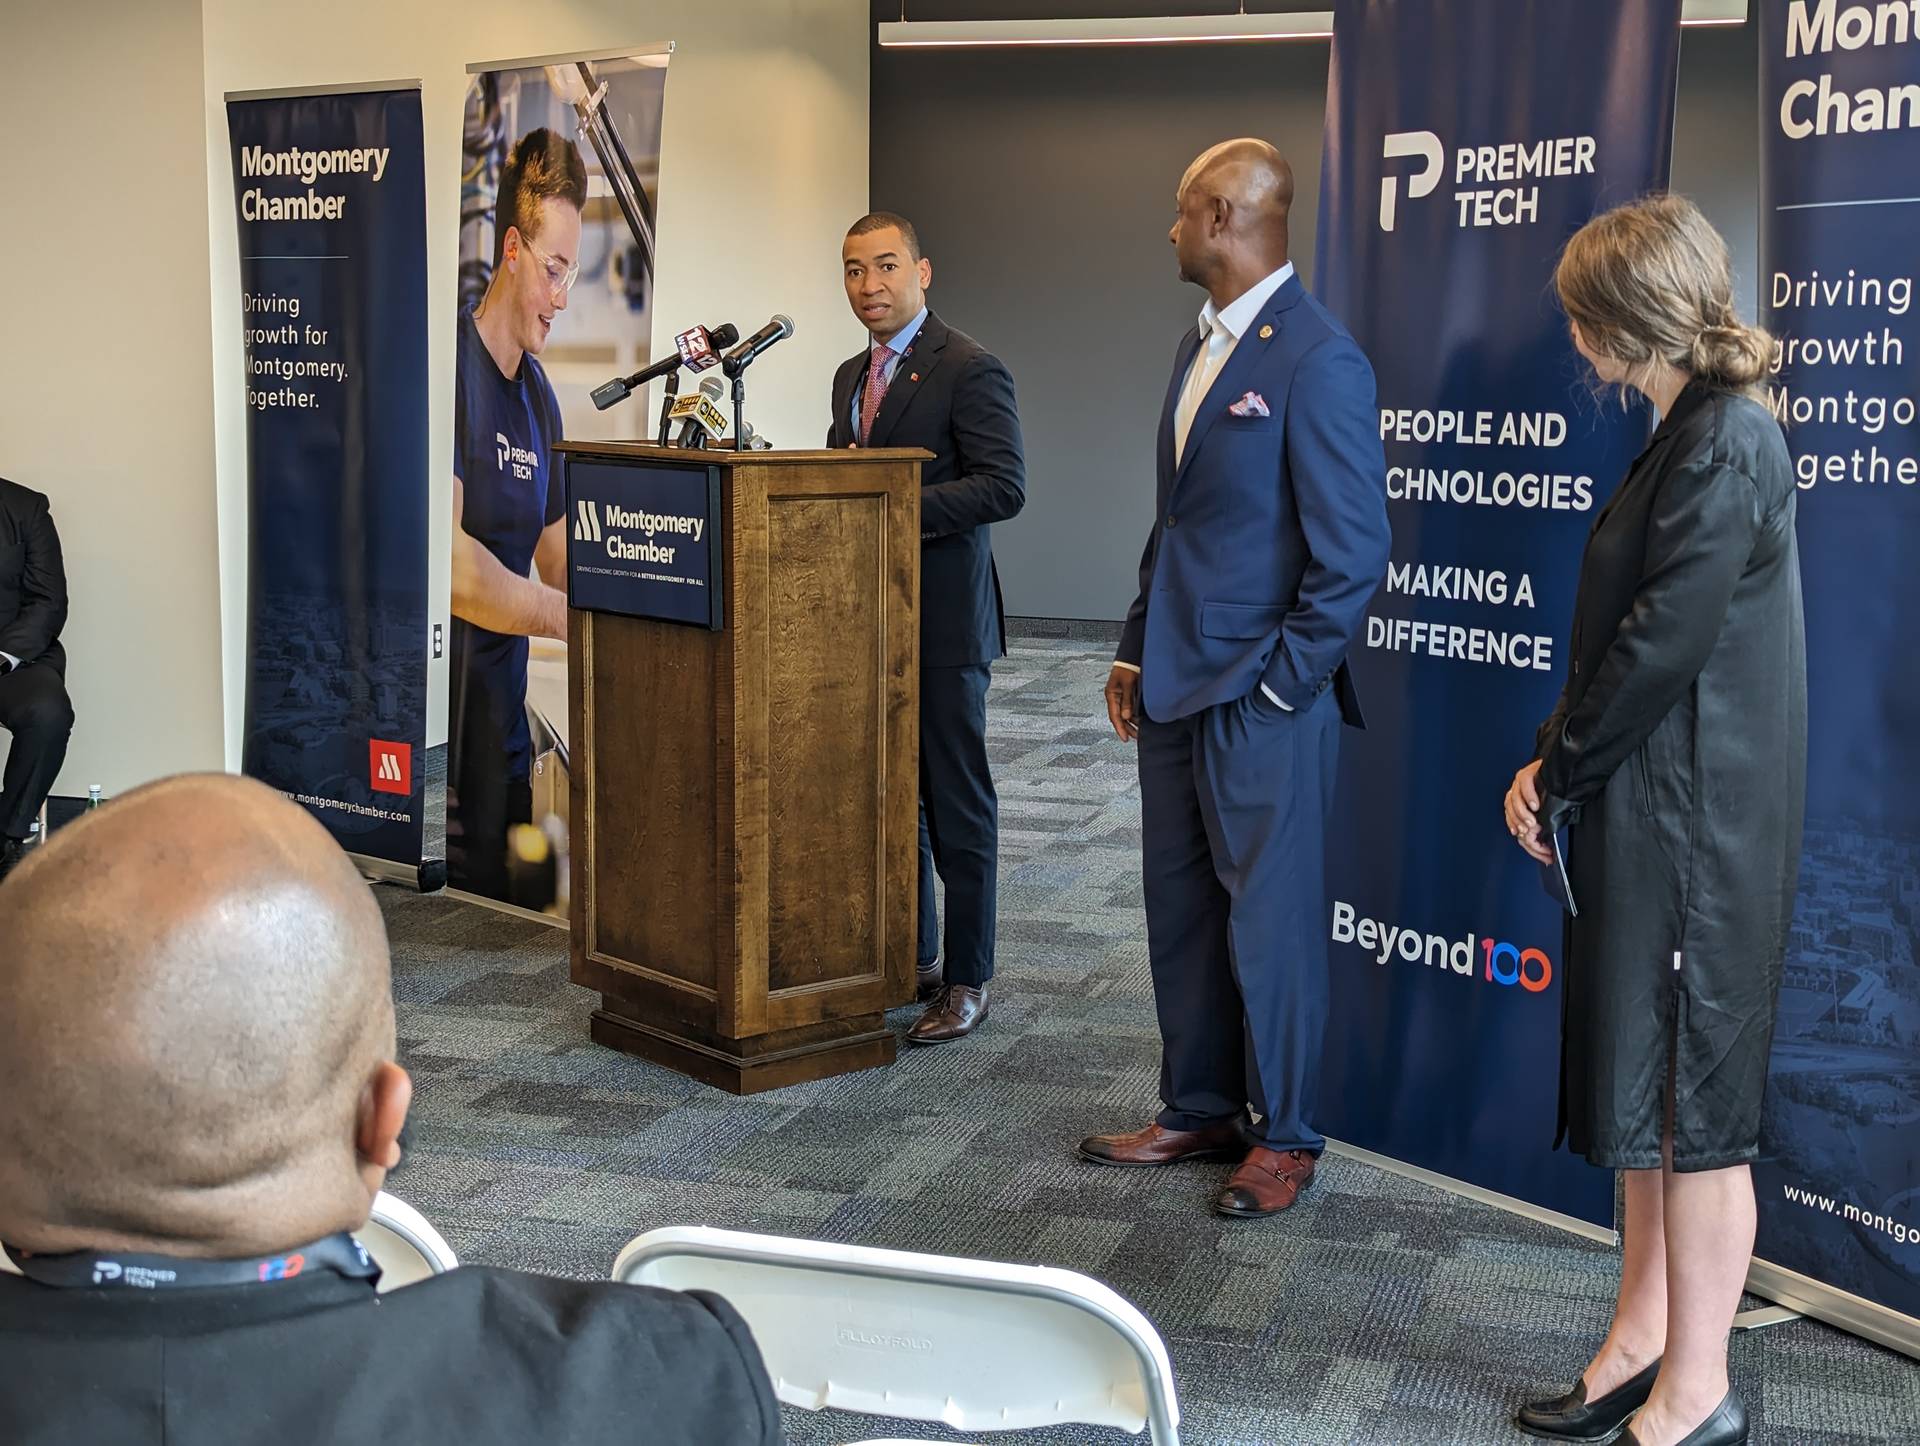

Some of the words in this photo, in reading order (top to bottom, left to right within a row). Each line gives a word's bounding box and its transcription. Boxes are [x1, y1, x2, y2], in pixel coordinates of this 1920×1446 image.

[242, 146, 389, 184] Montgomery
[1456, 136, 1596, 184] PREMIER
[242, 188, 345, 221] Chamber
[1455, 186, 1539, 228] TECH
[244, 293, 300, 318] Driving
[1772, 269, 1912, 315] Driving
[245, 325, 298, 347] growth
[305, 325, 328, 345] for
[687, 327, 708, 356] 12
[1769, 327, 1903, 374] growth
[246, 355, 349, 382] Montgomery.
[246, 385, 320, 410] Together.
[1379, 409, 1493, 444] PEOPLE
[1497, 411, 1567, 447] AND
[512, 463, 532, 480] TECH
[606, 505, 704, 541] Montgomery
[606, 535, 675, 564] Chamber
[642, 572, 655, 580] BETTER
[656, 574, 684, 584] MONTGOMERY
[687, 577, 695, 585] FOR
[1387, 561, 1507, 605] MAKING
[1513, 574, 1535, 608] A
[1367, 616, 1552, 671] DIFFERENCE
[1332, 901, 1475, 976] Beyond
[1481, 937, 1552, 993] 100
[1784, 1185, 1920, 1244] www.montgo
[124, 1266, 177, 1283] PREMIER
